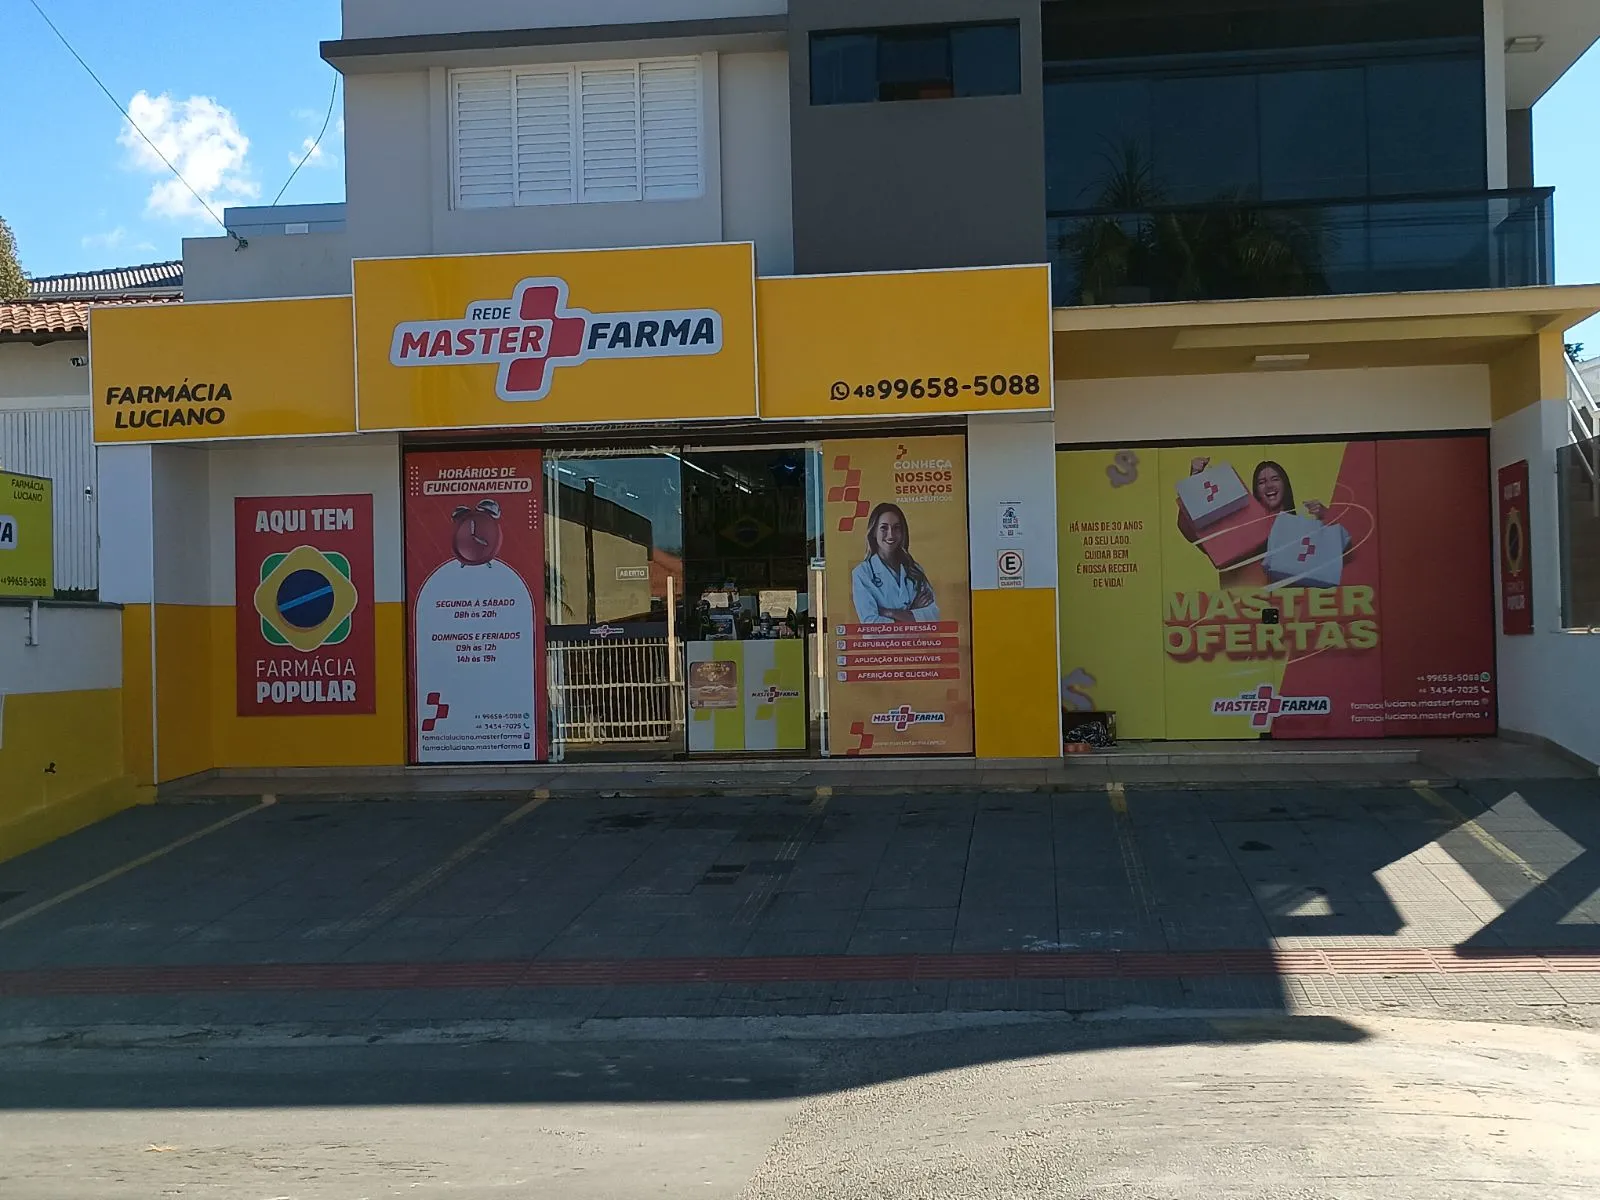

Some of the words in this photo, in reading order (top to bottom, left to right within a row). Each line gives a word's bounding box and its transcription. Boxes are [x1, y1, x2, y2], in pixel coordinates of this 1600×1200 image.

[472, 307, 512, 321] REDE
[399, 326, 545, 359] MASTER
[586, 317, 715, 350] FARMA
[106, 378, 234, 406] FARMÁCIA
[853, 384, 876, 398] 48
[876, 374, 1041, 400] 99658-5088
[114, 406, 226, 429] LUCIANO
[438, 466, 499, 479] HORÁRIOS
[500, 467, 517, 477] DE
[893, 459, 953, 473] CONHEÇA
[894, 470, 952, 483] NOSSOS
[11, 478, 45, 492] FARMÁCIA
[426, 480, 529, 493] FUNCIONAMENTO
[895, 484, 953, 497] SERVIÇOS
[13, 490, 43, 502] LUCIANO
[255, 509, 306, 534] AQUI
[311, 508, 354, 531] TEM
[1069, 520, 1080, 533] HÁ
[1081, 522, 1100, 532] MAIS
[1100, 521, 1111, 531] DE
[1112, 521, 1122, 531] 30
[1123, 520, 1144, 530] ANOS
[1083, 536, 1093, 546] AO
[1094, 535, 1109, 546] SEU
[1084, 550, 1111, 560] CUIDAR
[1113, 549, 1129, 559] BEM
[1006, 556, 1016, 570] E
[1076, 563, 1082, 574] É
[1083, 564, 1107, 574] NOSSA
[1108, 563, 1138, 573] RECEITA
[1093, 578, 1103, 588] DE
[1104, 577, 1124, 588] VIDA!
[435, 599, 473, 609] SEGUNDA
[482, 597, 516, 607] SÁBADO
[1164, 585, 1375, 621] MASTER
[481, 610, 497, 618] 20h
[857, 624, 893, 635] AFERIÇÃO
[893, 625, 903, 633] DE
[904, 624, 938, 632] PRESSÃO
[431, 632, 474, 642] DOMINGOS
[475, 633, 480, 641] E
[481, 631, 521, 641] FERIADOS
[1164, 619, 1379, 655] OFERTAS
[455, 643, 472, 652] 09h
[483, 643, 497, 651] 12h
[853, 639, 900, 649] PERFURAÇÃO
[912, 638, 942, 647] LÓBULO
[256, 655, 356, 677] FARMÁCIA
[854, 655, 893, 665] APLICAÇÃO
[893, 655, 903, 663] DE
[857, 670, 893, 680] AFERIÇÃO
[905, 670, 939, 678] GLICEMIA
[256, 679, 356, 703] POPULAR
[1213, 700, 1268, 713] MASTER
[1280, 699, 1328, 711] FARMA
[873, 714, 907, 722] MASTER
[915, 713, 944, 721] FARMA
